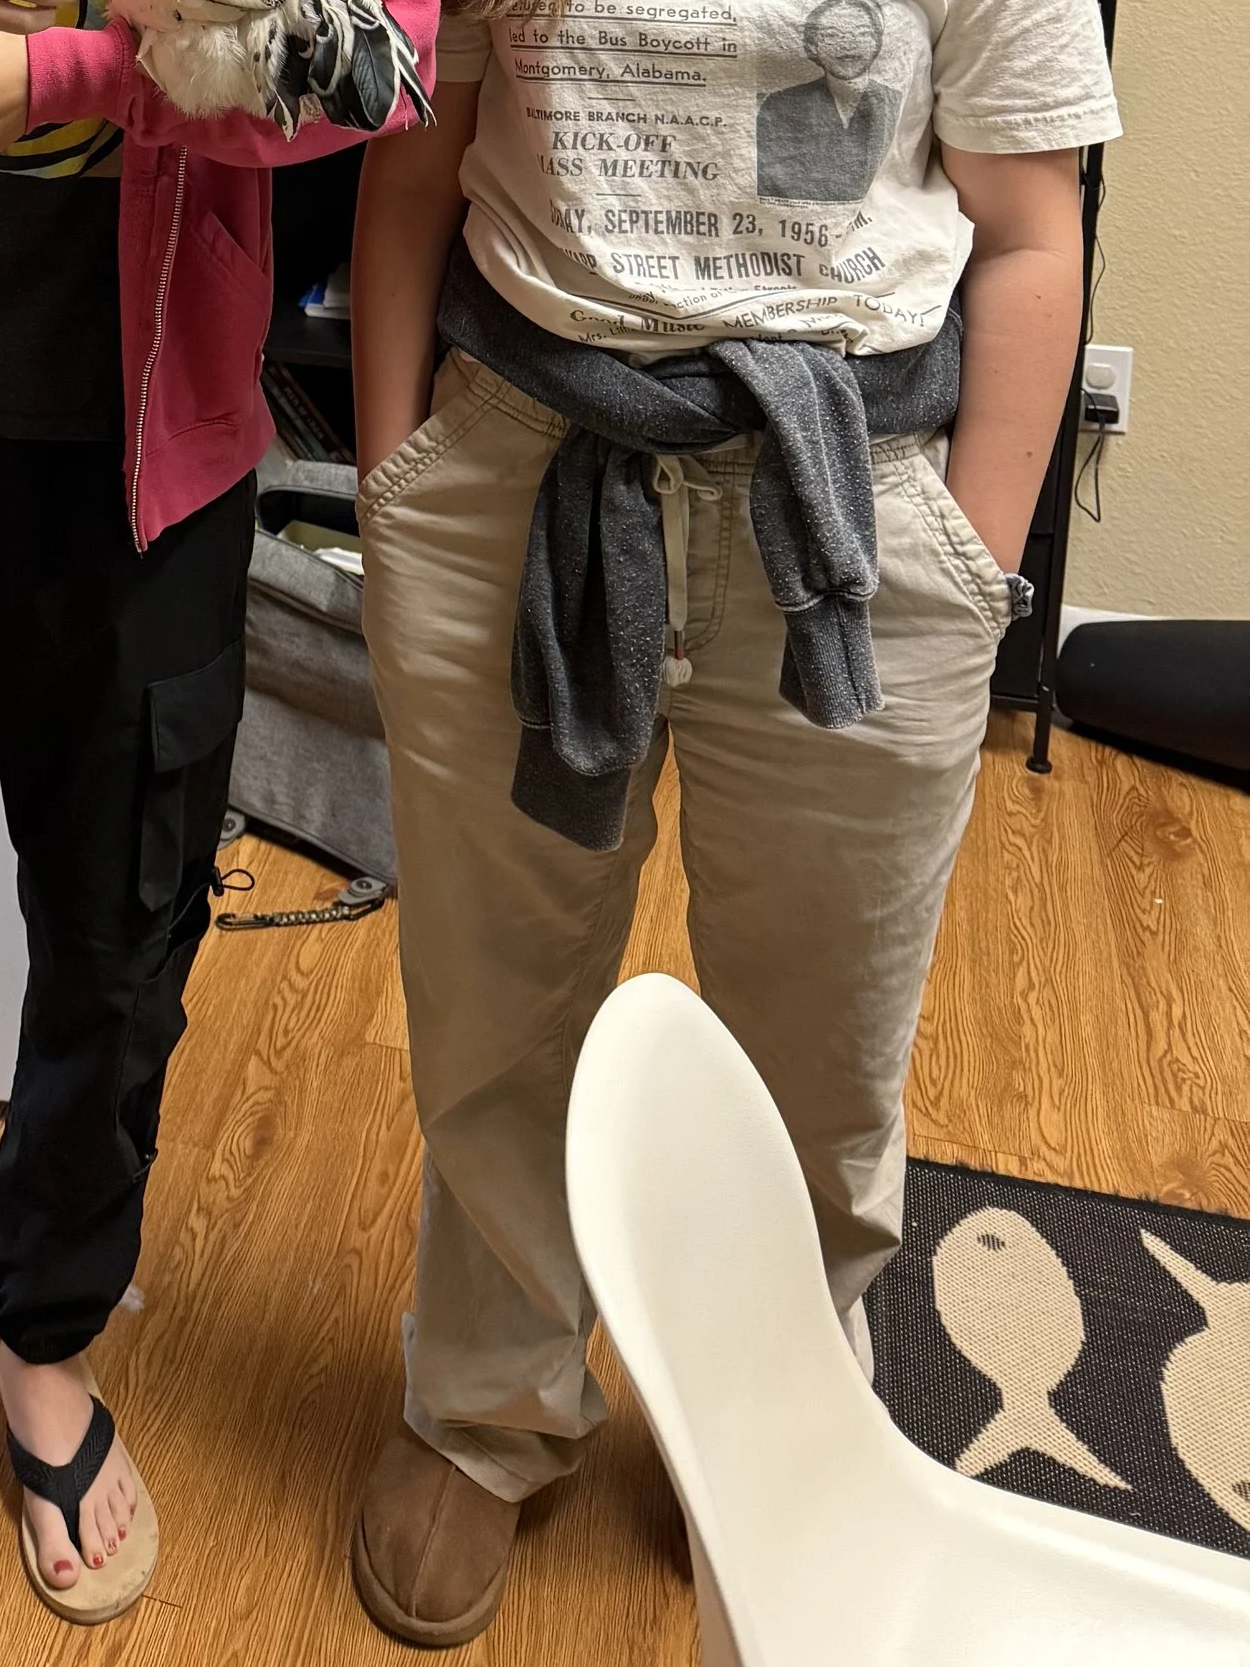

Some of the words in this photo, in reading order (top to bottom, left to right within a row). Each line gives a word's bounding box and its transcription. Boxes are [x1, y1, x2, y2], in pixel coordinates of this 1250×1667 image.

[567, 0, 585, 14] to
[626, 5, 737, 22] segregated,
[509, 28, 526, 43] led
[533, 31, 549, 44] to
[558, 29, 586, 45] the
[598, 31, 628, 47] Bus
[638, 31, 711, 51] Boycott
[722, 36, 737, 53] in
[514, 58, 611, 79] Montgomery,
[620, 62, 707, 82] Alabama.
[526, 106, 581, 122] BALTIMORE
[587, 110, 647, 124] BRANCH
[654, 113, 727, 127] N.A.A.C.P.
[552, 130, 676, 153] KICK-OFF
[598, 158, 720, 181] MEETING
[604, 208, 720, 237] SEPTEMBER
[732, 212, 764, 237] 23,
[778, 218, 829, 248] 1956
[612, 251, 681, 281] STREET
[694, 251, 806, 281] METHODIST
[818, 246, 886, 284] CHURCH
[721, 296, 838, 330] MEMBERSHIP
[853, 294, 926, 327] TODAY!
[577, 332, 607, 344] Mrs.
